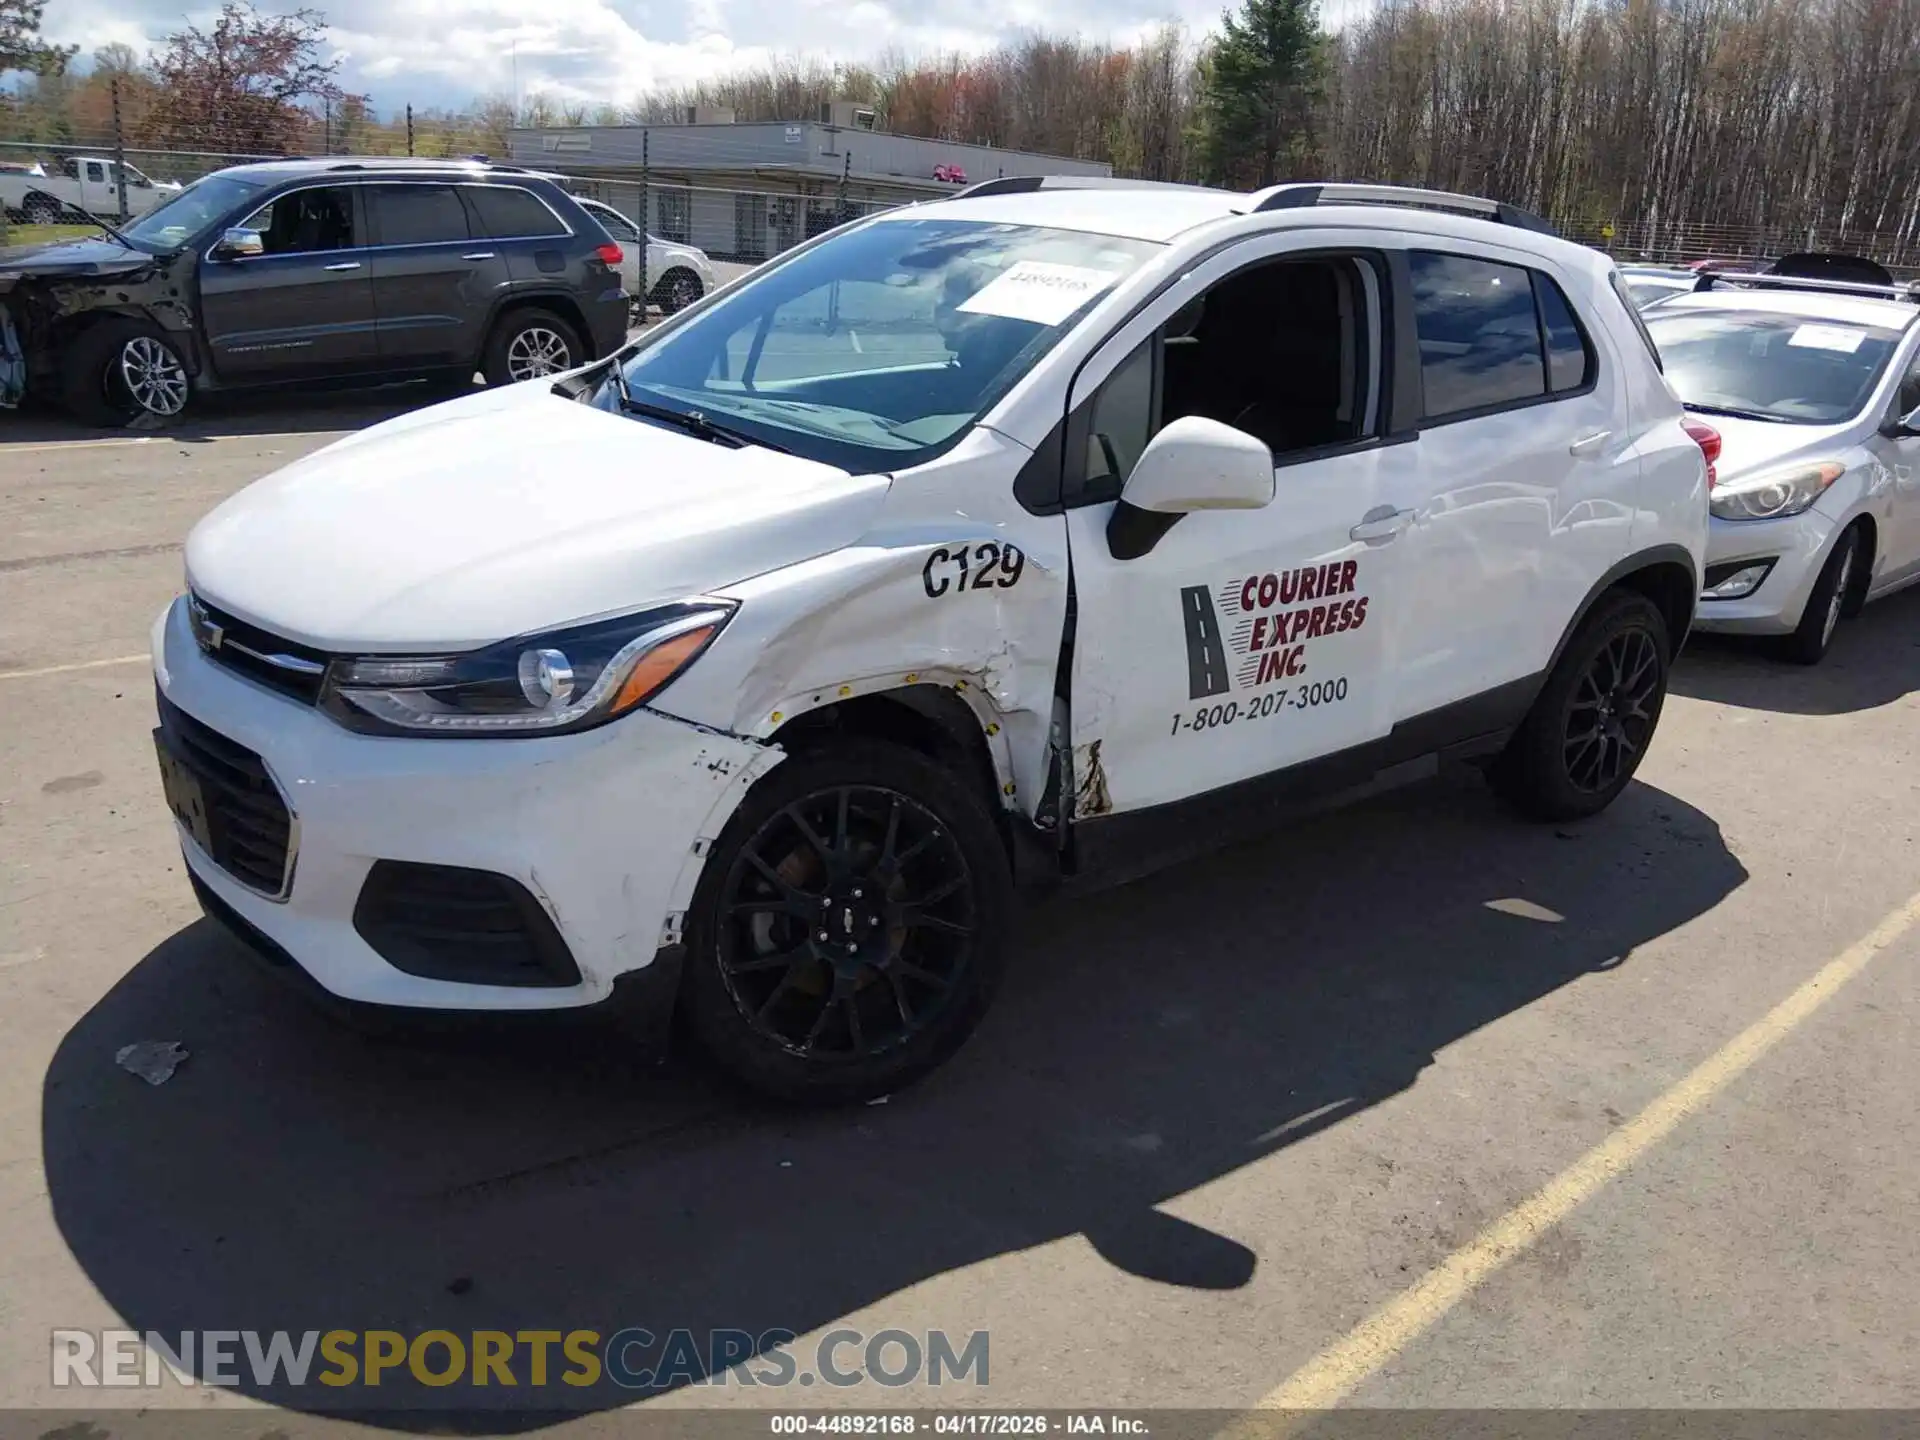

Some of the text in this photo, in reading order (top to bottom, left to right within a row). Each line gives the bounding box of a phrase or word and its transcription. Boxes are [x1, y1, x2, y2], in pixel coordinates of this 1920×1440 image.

[922, 541, 1025, 598] C129
[1240, 560, 1358, 612] COURIER
[1249, 596, 1370, 652] EXPRESS
[1254, 645, 1307, 686] INC.
[1171, 677, 1348, 736] 1-800-207-3000
